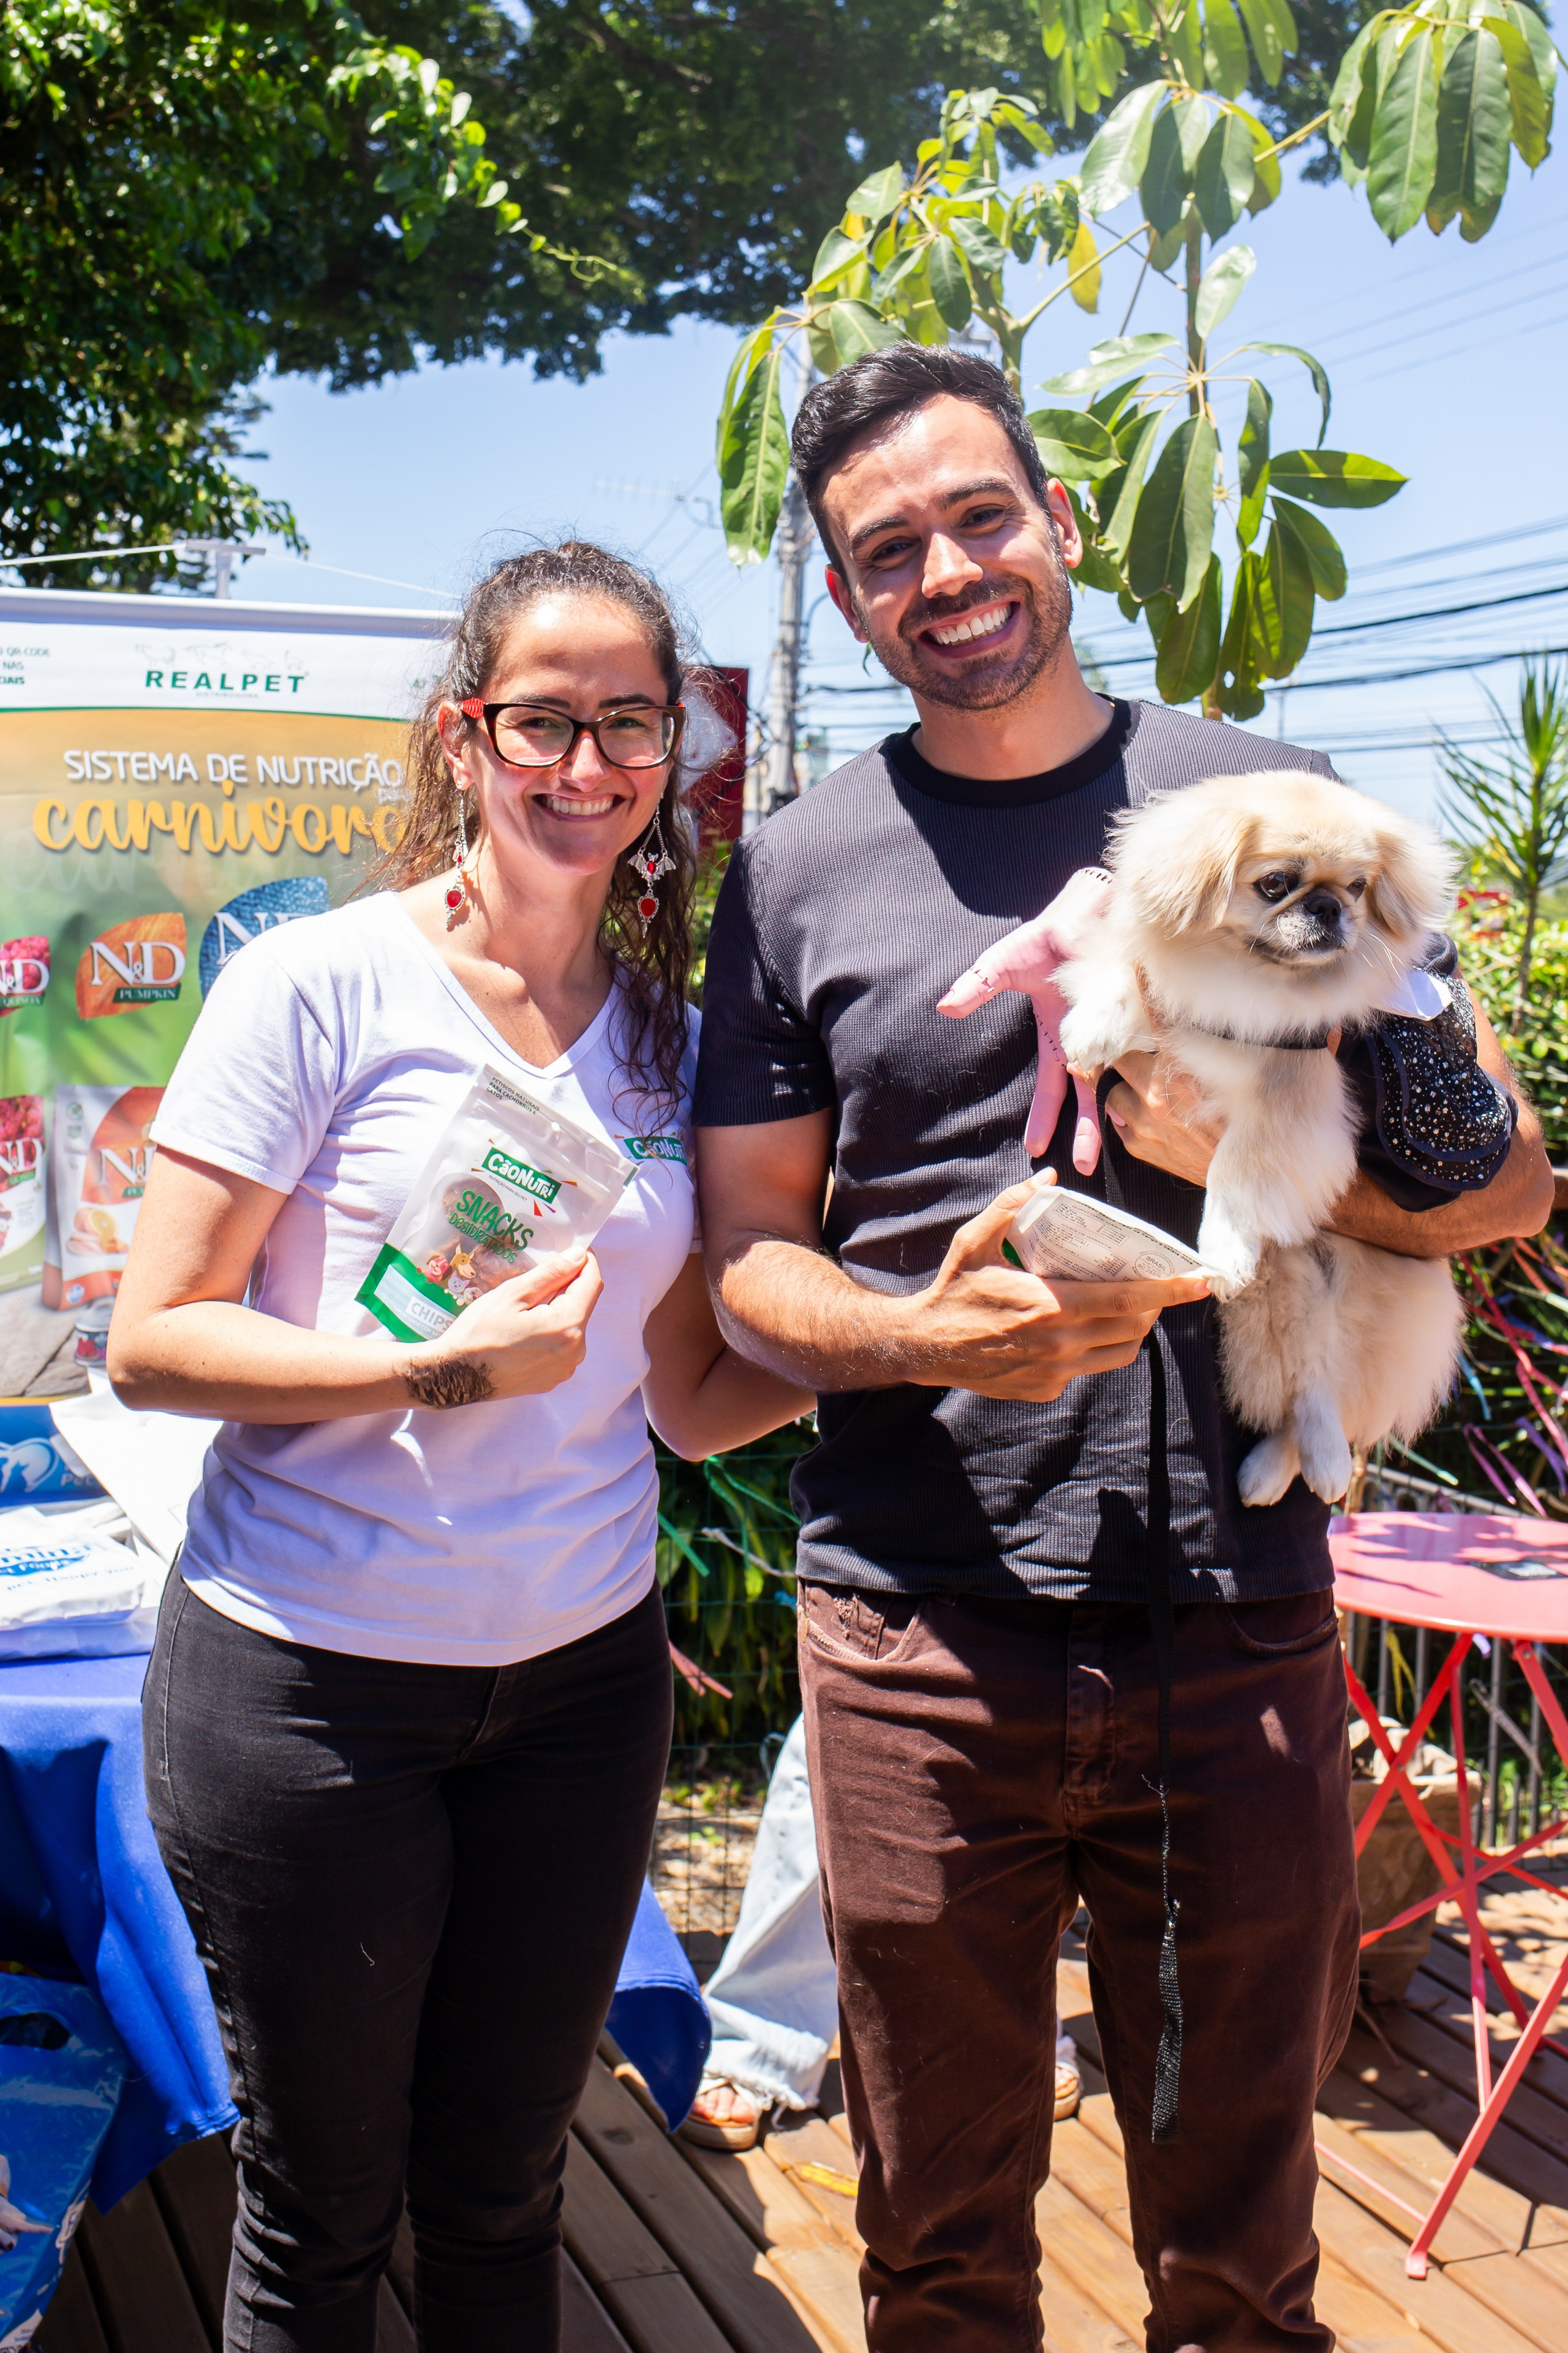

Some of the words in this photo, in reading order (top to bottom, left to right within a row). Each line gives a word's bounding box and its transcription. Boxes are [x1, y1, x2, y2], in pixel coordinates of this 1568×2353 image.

[145, 670, 305, 693] REALPET
[63, 749, 198, 782] SISTEMA
[206, 753, 247, 783] DE
[257, 752, 404, 792] NUTRIÇÃO
[89, 940, 186, 986] N&D
[119, 988, 177, 1000] PUMPKIN
[486, 1087, 503, 1100] GATOS
[489, 1081, 502, 1093] PARA
[502, 1091, 532, 1112] CACHORROS
[492, 1076, 514, 1094] PETISCOS
[515, 1092, 540, 1111] NATURAIS
[489, 1174, 505, 1188] NUTRIÇÃO
[505, 1185, 514, 1193] PARA
[456, 1189, 534, 1250] SNACKS
[1145, 1256, 1167, 1271] BRASIL
[411, 1302, 453, 1331] CHIPS
